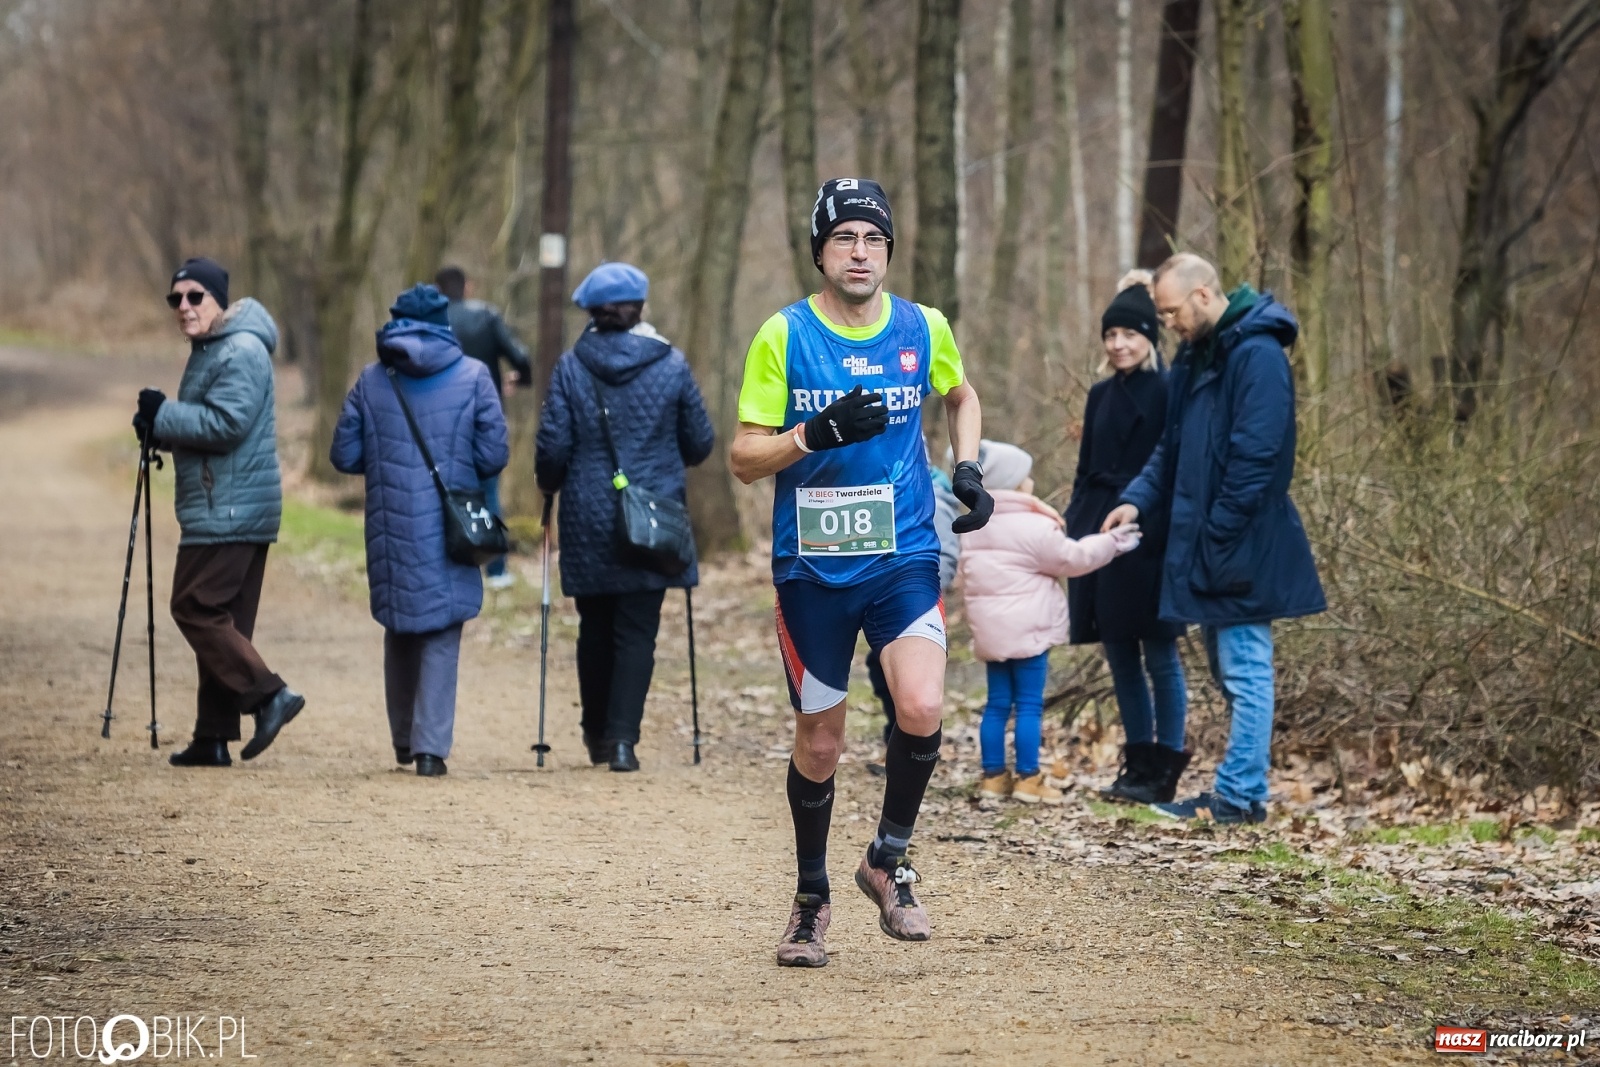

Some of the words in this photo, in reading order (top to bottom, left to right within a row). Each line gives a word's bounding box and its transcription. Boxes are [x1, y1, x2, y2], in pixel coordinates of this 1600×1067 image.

[884, 415, 908, 425] EAM
[835, 488, 882, 498] Twardziela
[820, 509, 872, 535] 018
